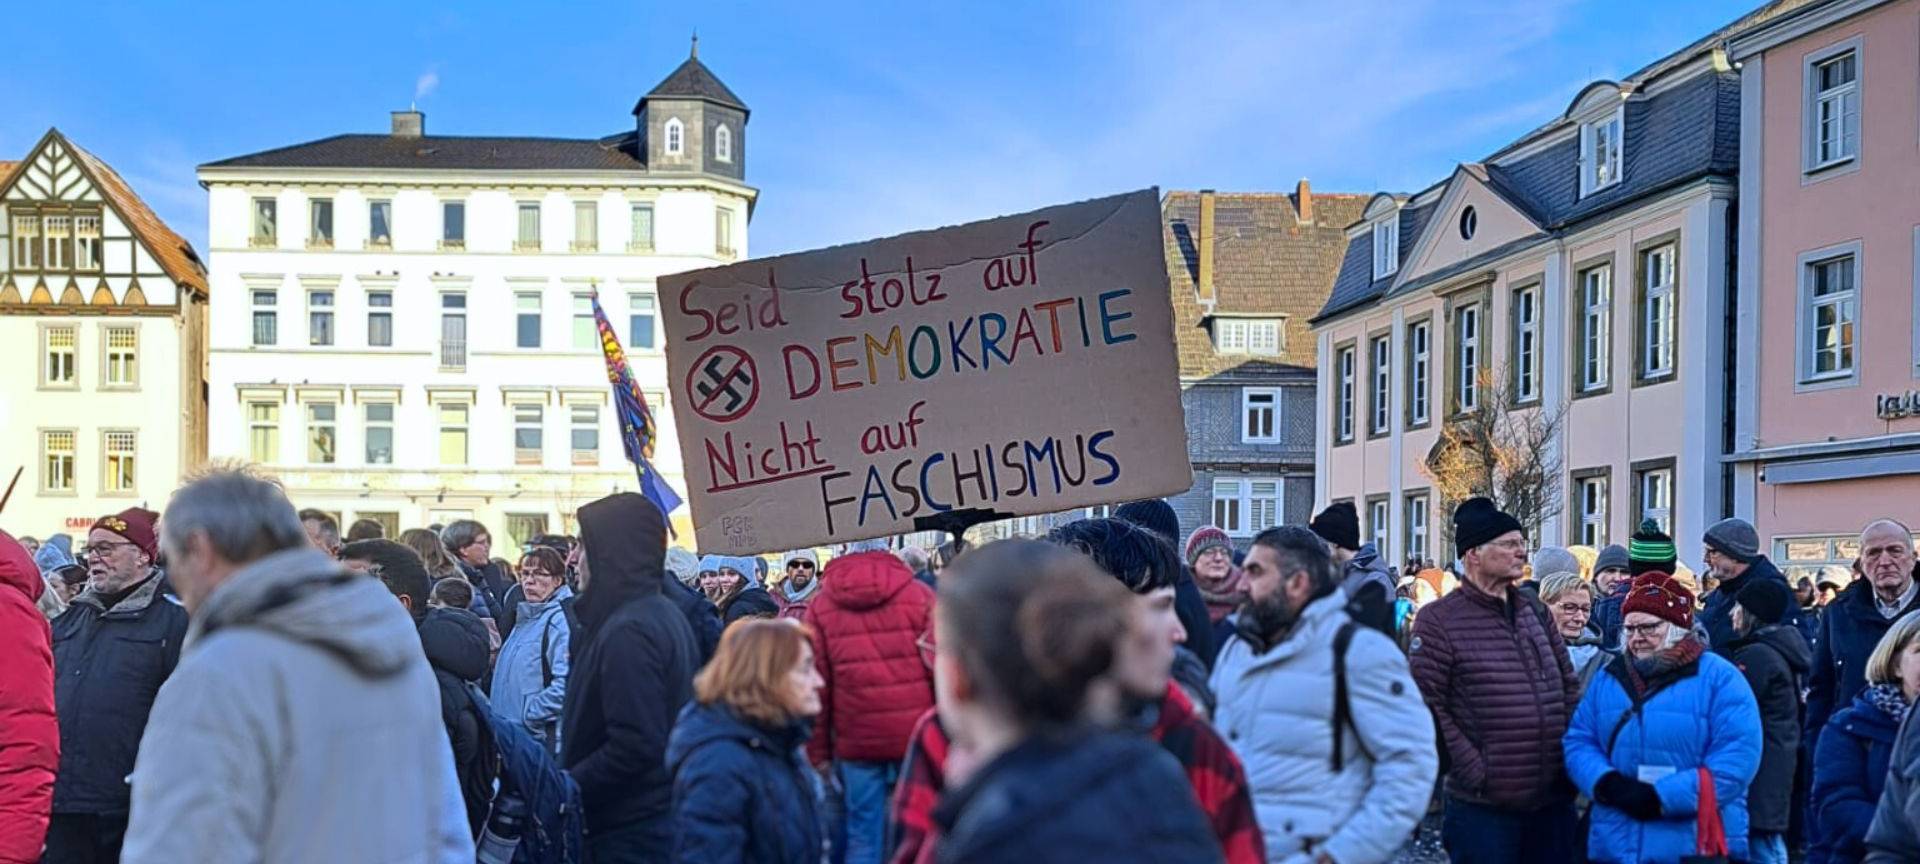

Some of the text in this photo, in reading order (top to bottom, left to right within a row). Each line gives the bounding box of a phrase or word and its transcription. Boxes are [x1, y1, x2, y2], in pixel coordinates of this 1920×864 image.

[680, 220, 1050, 341] Seid stolz auf
[782, 288, 1138, 400] DEMOKRATIE
[704, 400, 926, 489] Nicht auf
[820, 430, 1121, 535] FASCHISMUS
